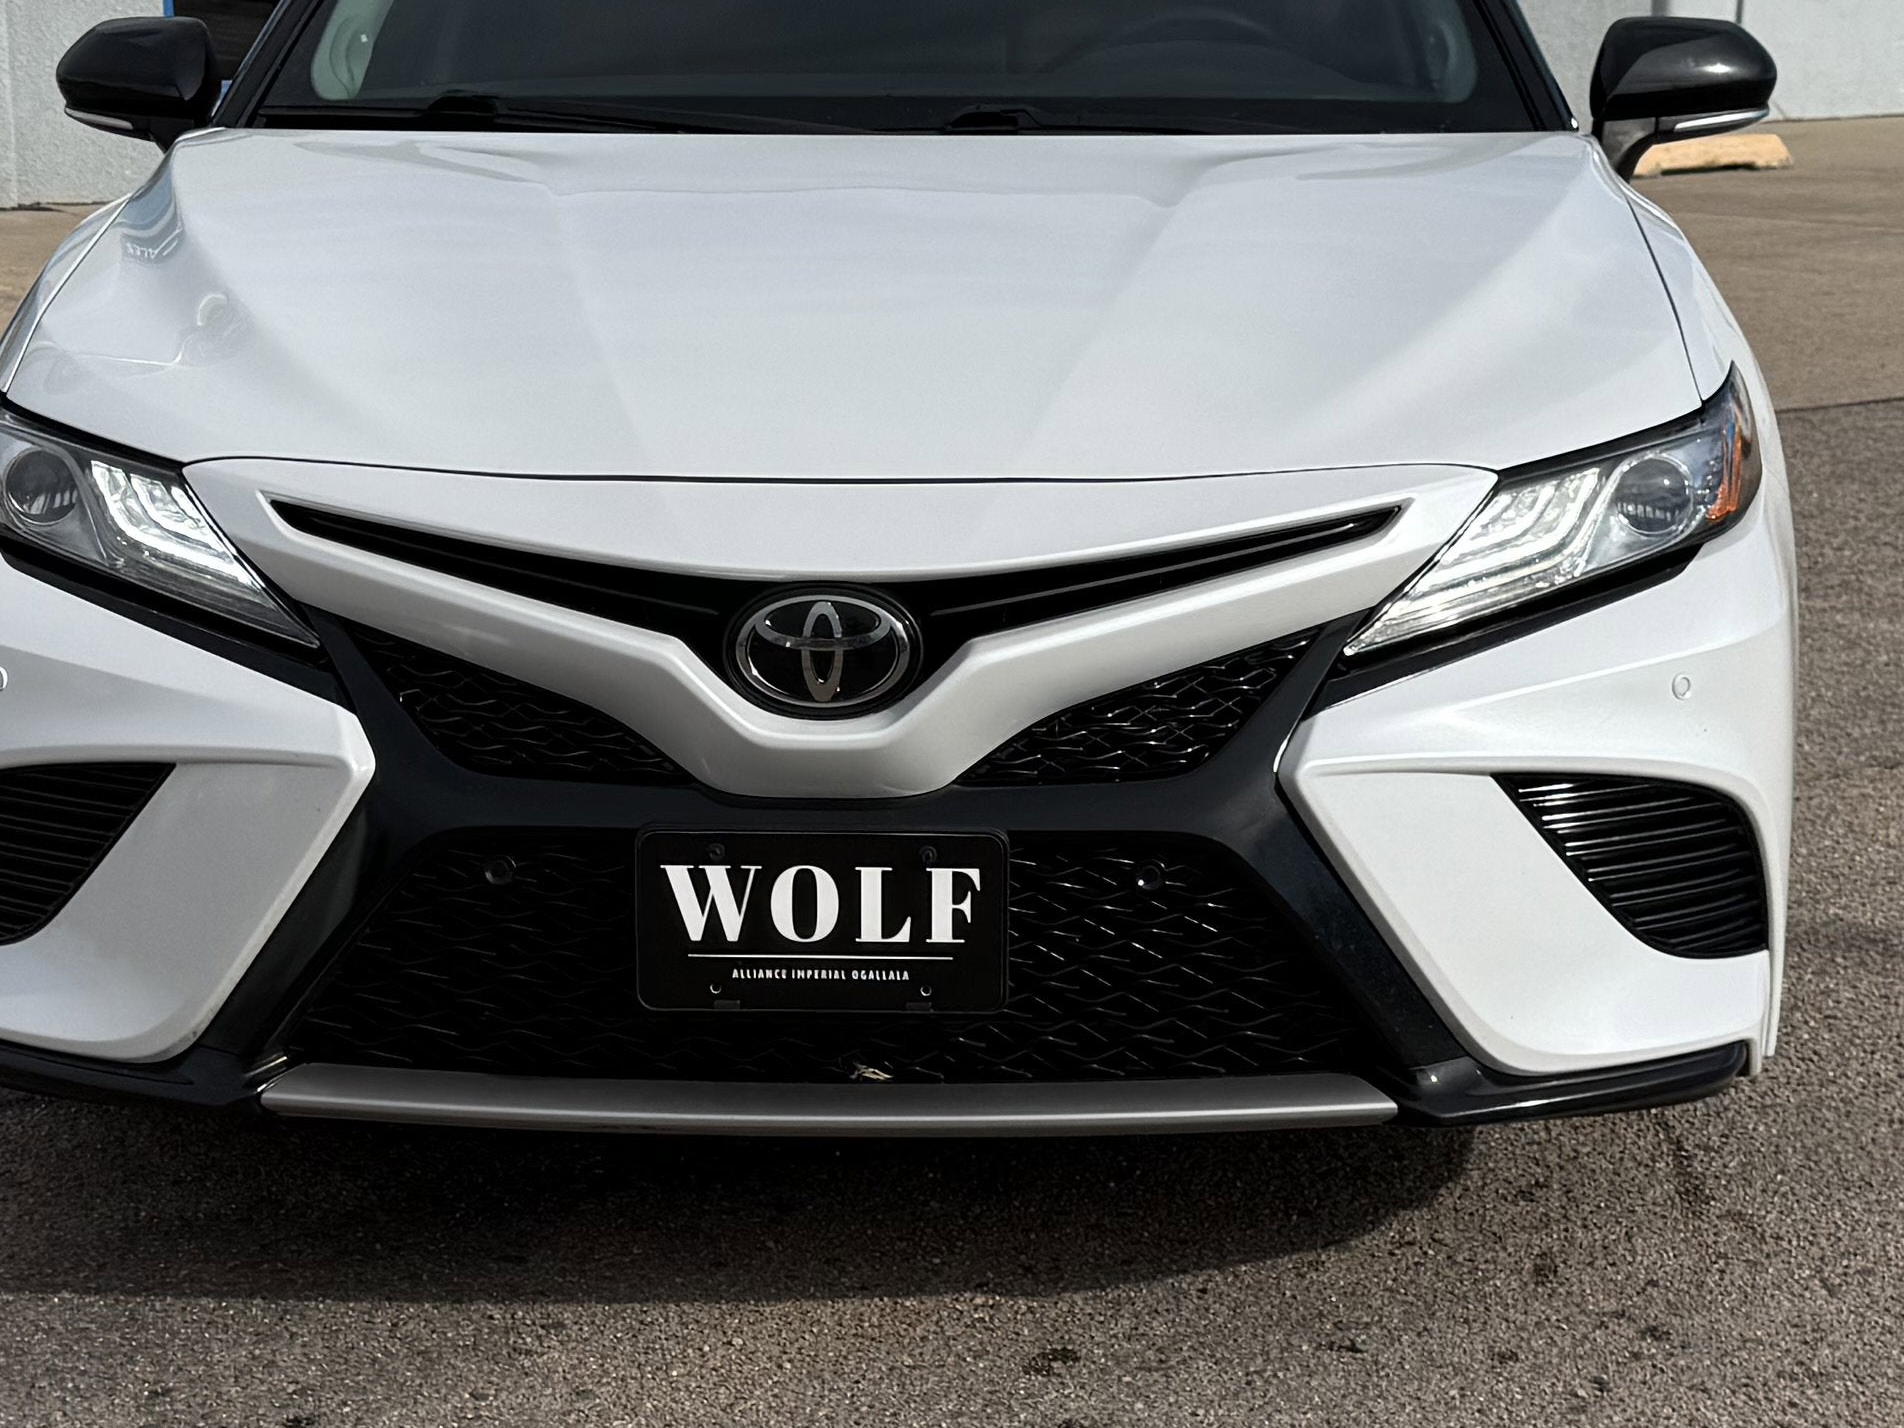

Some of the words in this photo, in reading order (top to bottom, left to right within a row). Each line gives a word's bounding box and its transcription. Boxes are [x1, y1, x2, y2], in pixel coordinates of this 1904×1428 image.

[660, 865, 981, 943] WOLF
[732, 968, 787, 980] ALLIANCE
[791, 969, 847, 980] IMPERIAL
[851, 969, 910, 981] OGALLALA
